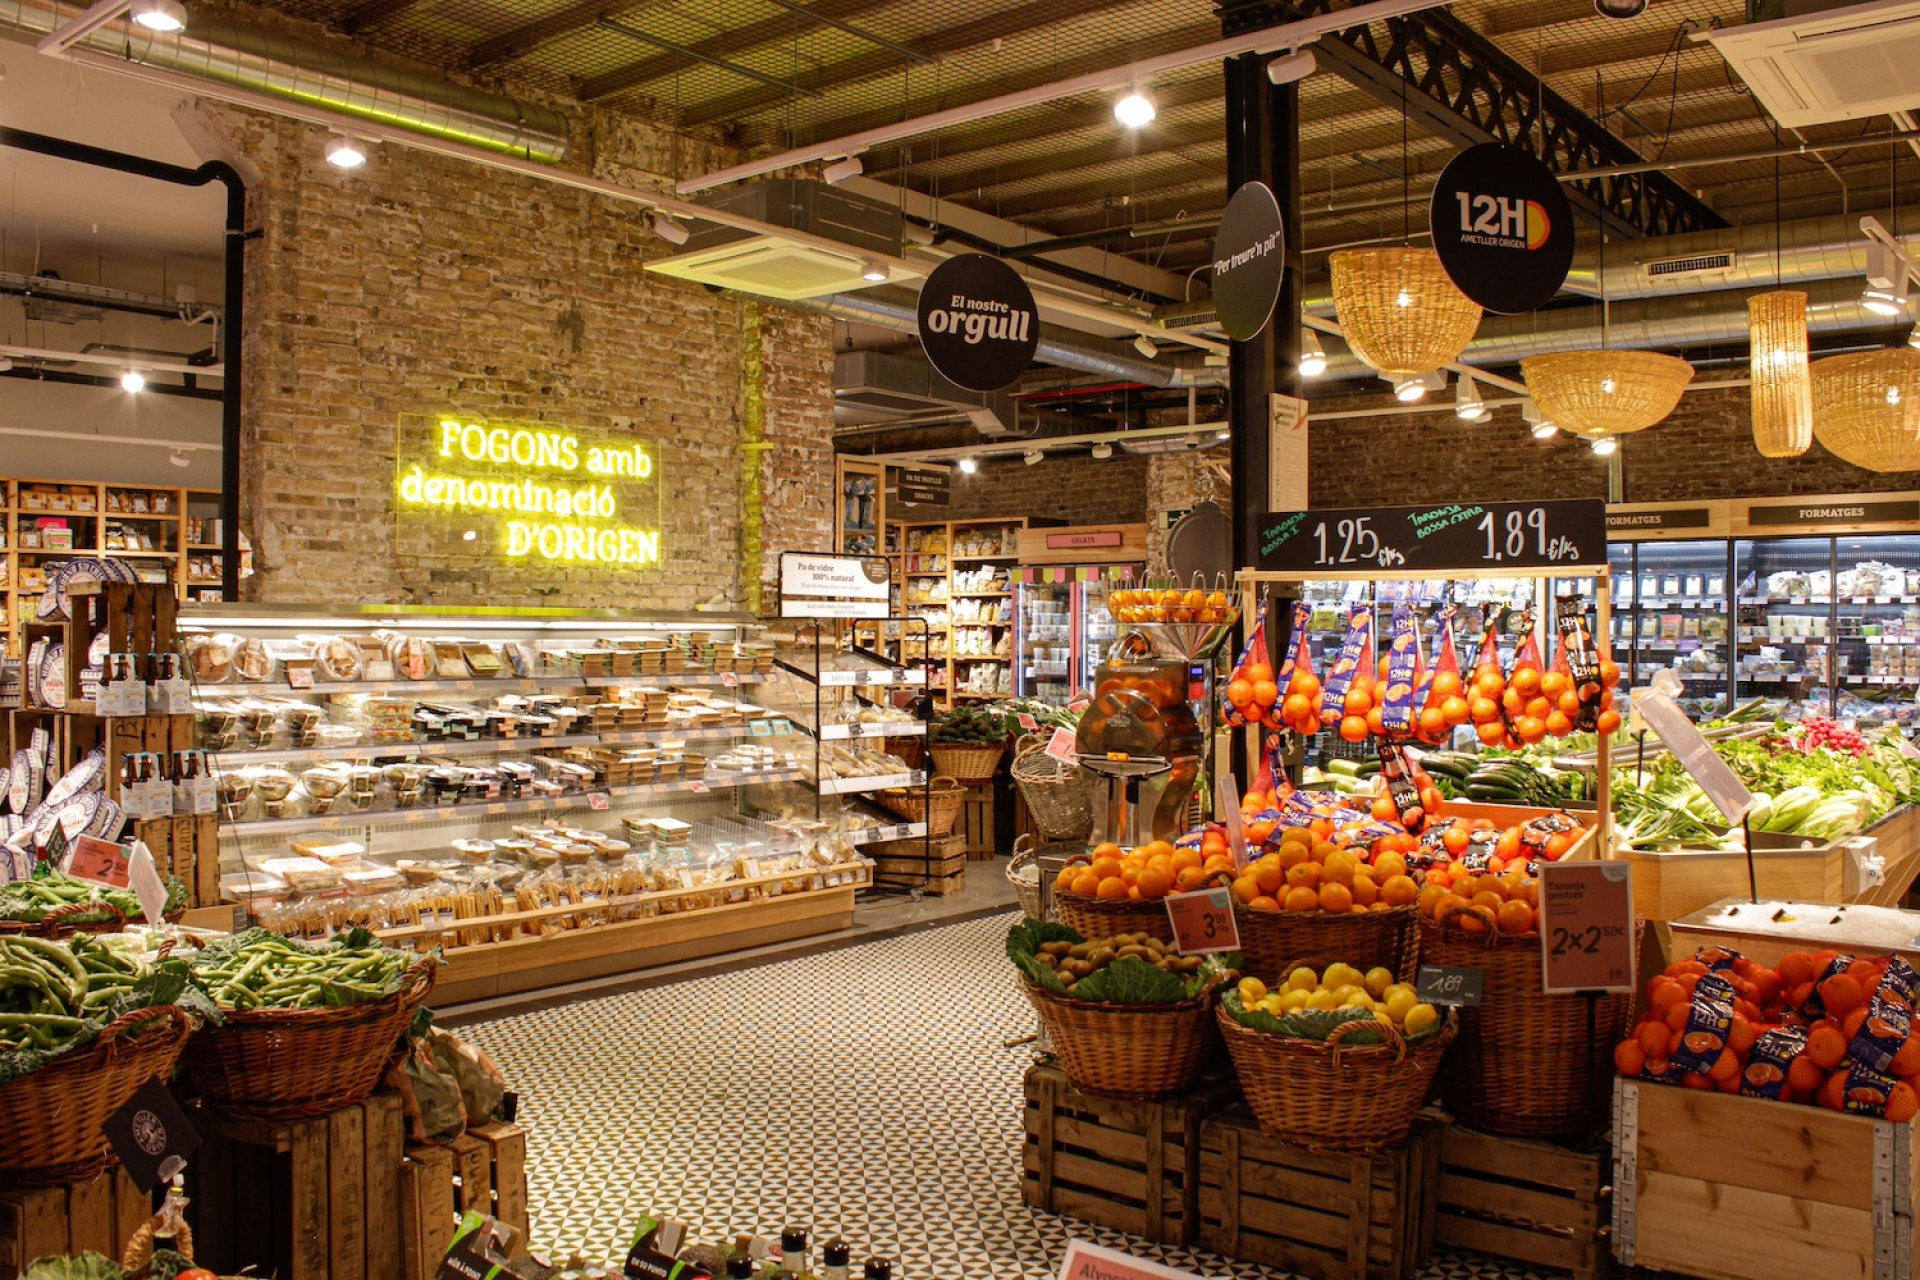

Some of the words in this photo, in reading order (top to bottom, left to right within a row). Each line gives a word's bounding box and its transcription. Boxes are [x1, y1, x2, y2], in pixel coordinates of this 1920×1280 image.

[1455, 191, 1526, 238] 12H
[1460, 234, 1498, 246] AMETLLER
[1499, 238, 1526, 249] ORIGEN
[951, 295, 965, 308] El
[967, 299, 1009, 313] nostre
[927, 309, 1030, 344] orgull
[438, 420, 579, 470] FOGONS
[586, 445, 653, 478] amb
[401, 466, 616, 518] denominació
[1407, 504, 1463, 526] TARONJA
[1800, 507, 1865, 518] FORMATGES
[1416, 519, 1450, 540] BOSSA
[1449, 506, 1485, 526] EXTRA
[506, 521, 660, 564] D'ORIGEN
[1071, 536, 1095, 544] GELATS
[1313, 517, 1380, 566] 1.25
[1477, 507, 1546, 561] 1.89
[798, 562, 807, 571] Pa
[808, 562, 815, 571] de
[817, 563, 834, 572] vidre
[830, 574, 855, 583] natural
[1390, 668, 1405, 678] 12H
[97, 858, 114, 877] 2
[1203, 912, 1216, 939] 3
[1693, 1010, 1717, 1026] 12H
[1755, 1039, 1780, 1056] 12H
